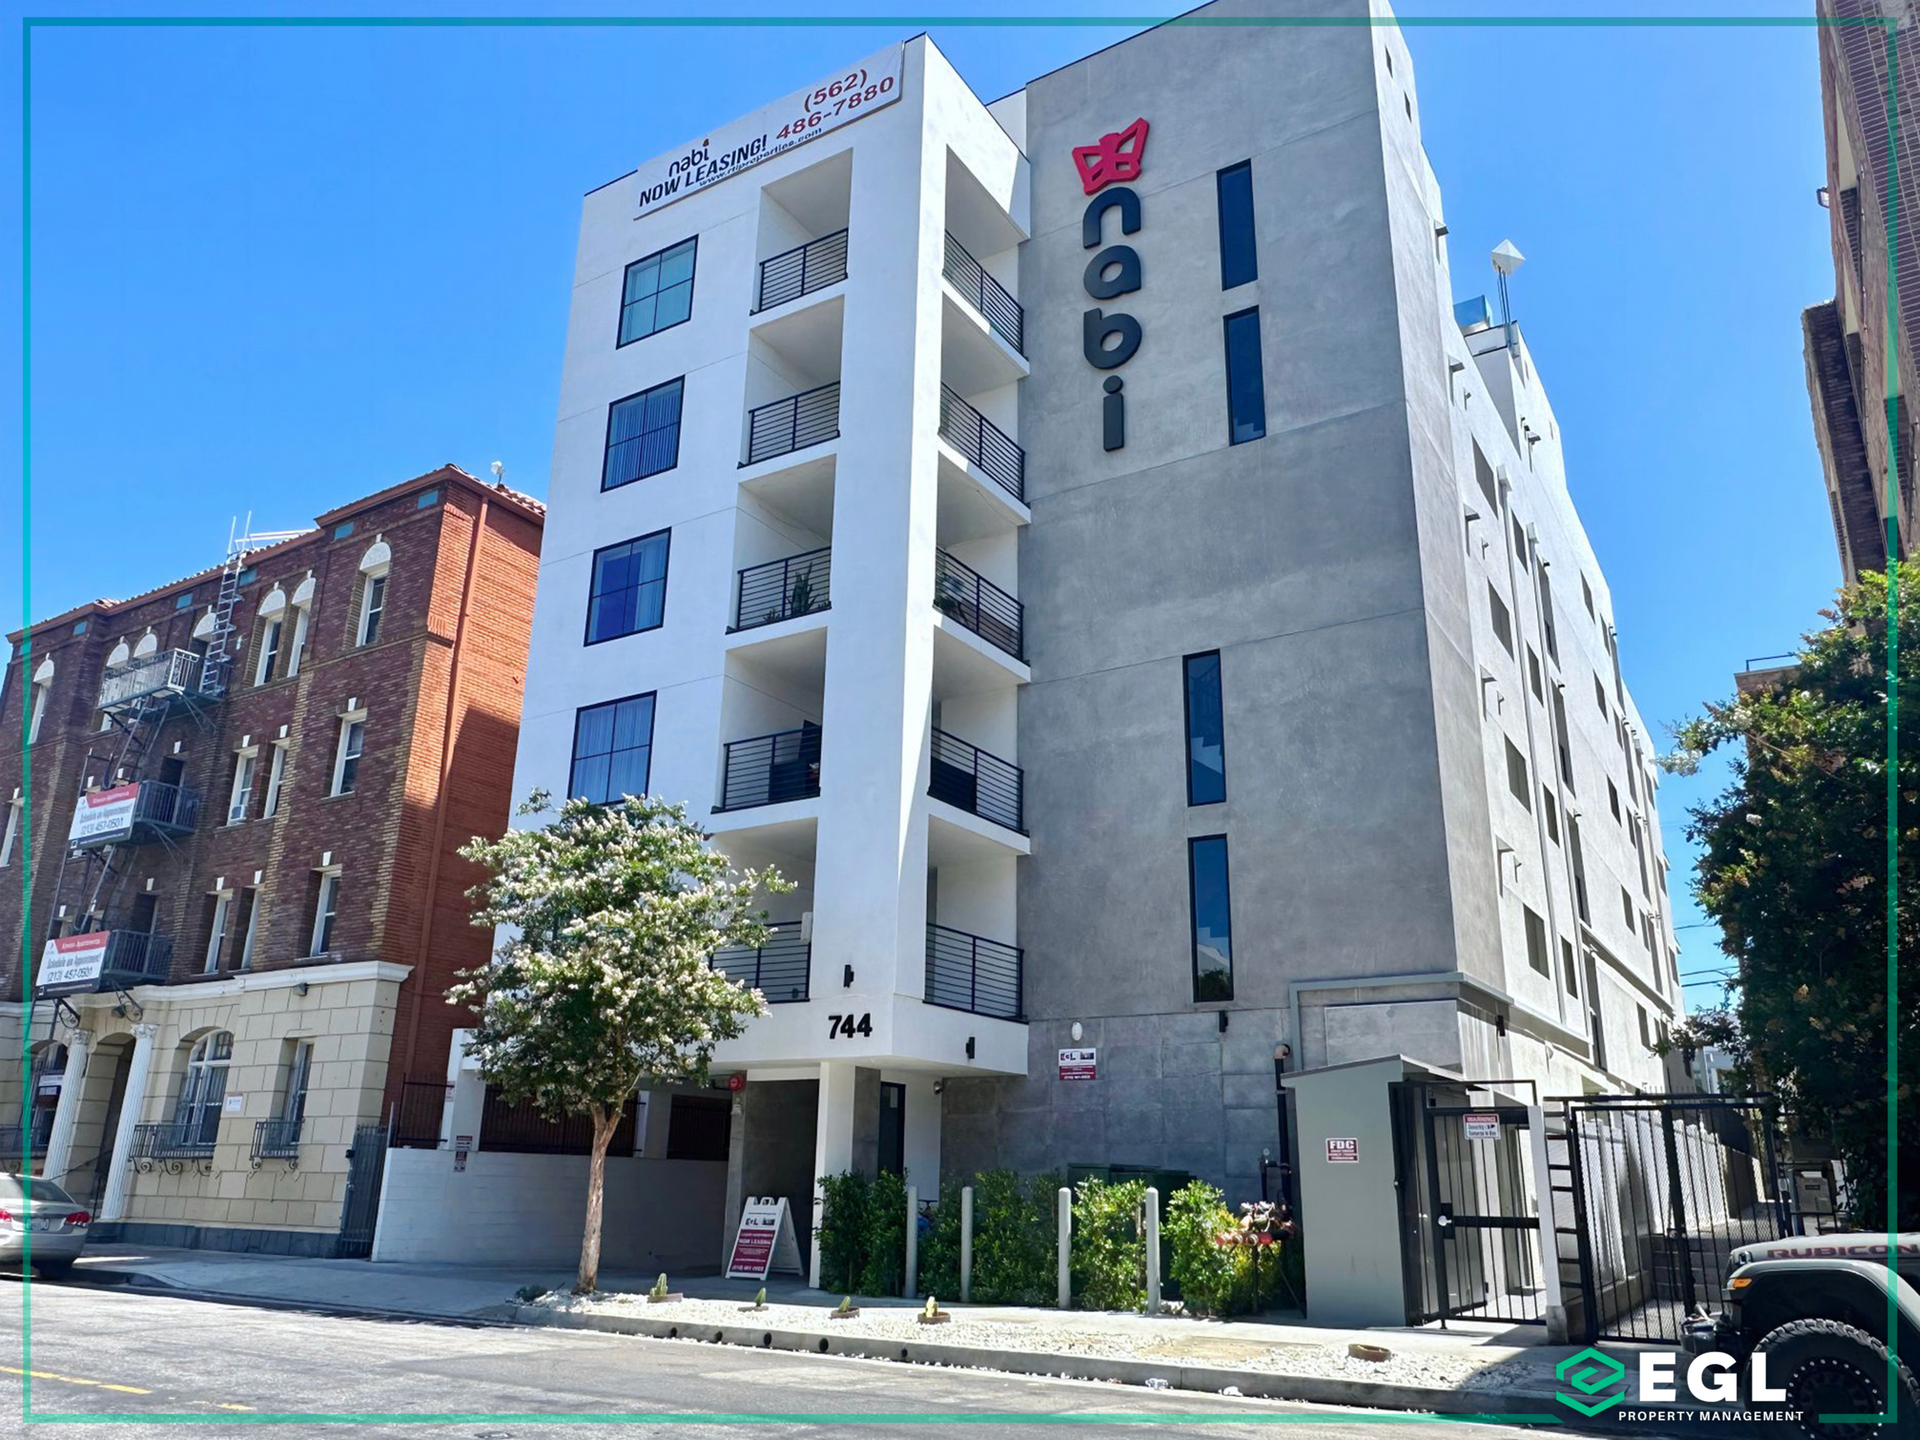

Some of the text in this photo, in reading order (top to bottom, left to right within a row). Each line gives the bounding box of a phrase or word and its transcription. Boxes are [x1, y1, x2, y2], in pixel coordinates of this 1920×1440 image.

[776, 76, 895, 140] 486-7880
[803, 69, 868, 112] (562)
[639, 134, 768, 208] NOW LEASING!
[668, 138, 710, 178] nabi
[1082, 186, 1142, 453] nabi
[828, 1013, 873, 1040] 744
[1330, 1140, 1355, 1150] FDC
[1767, 1244, 1919, 1259] RUBICON
